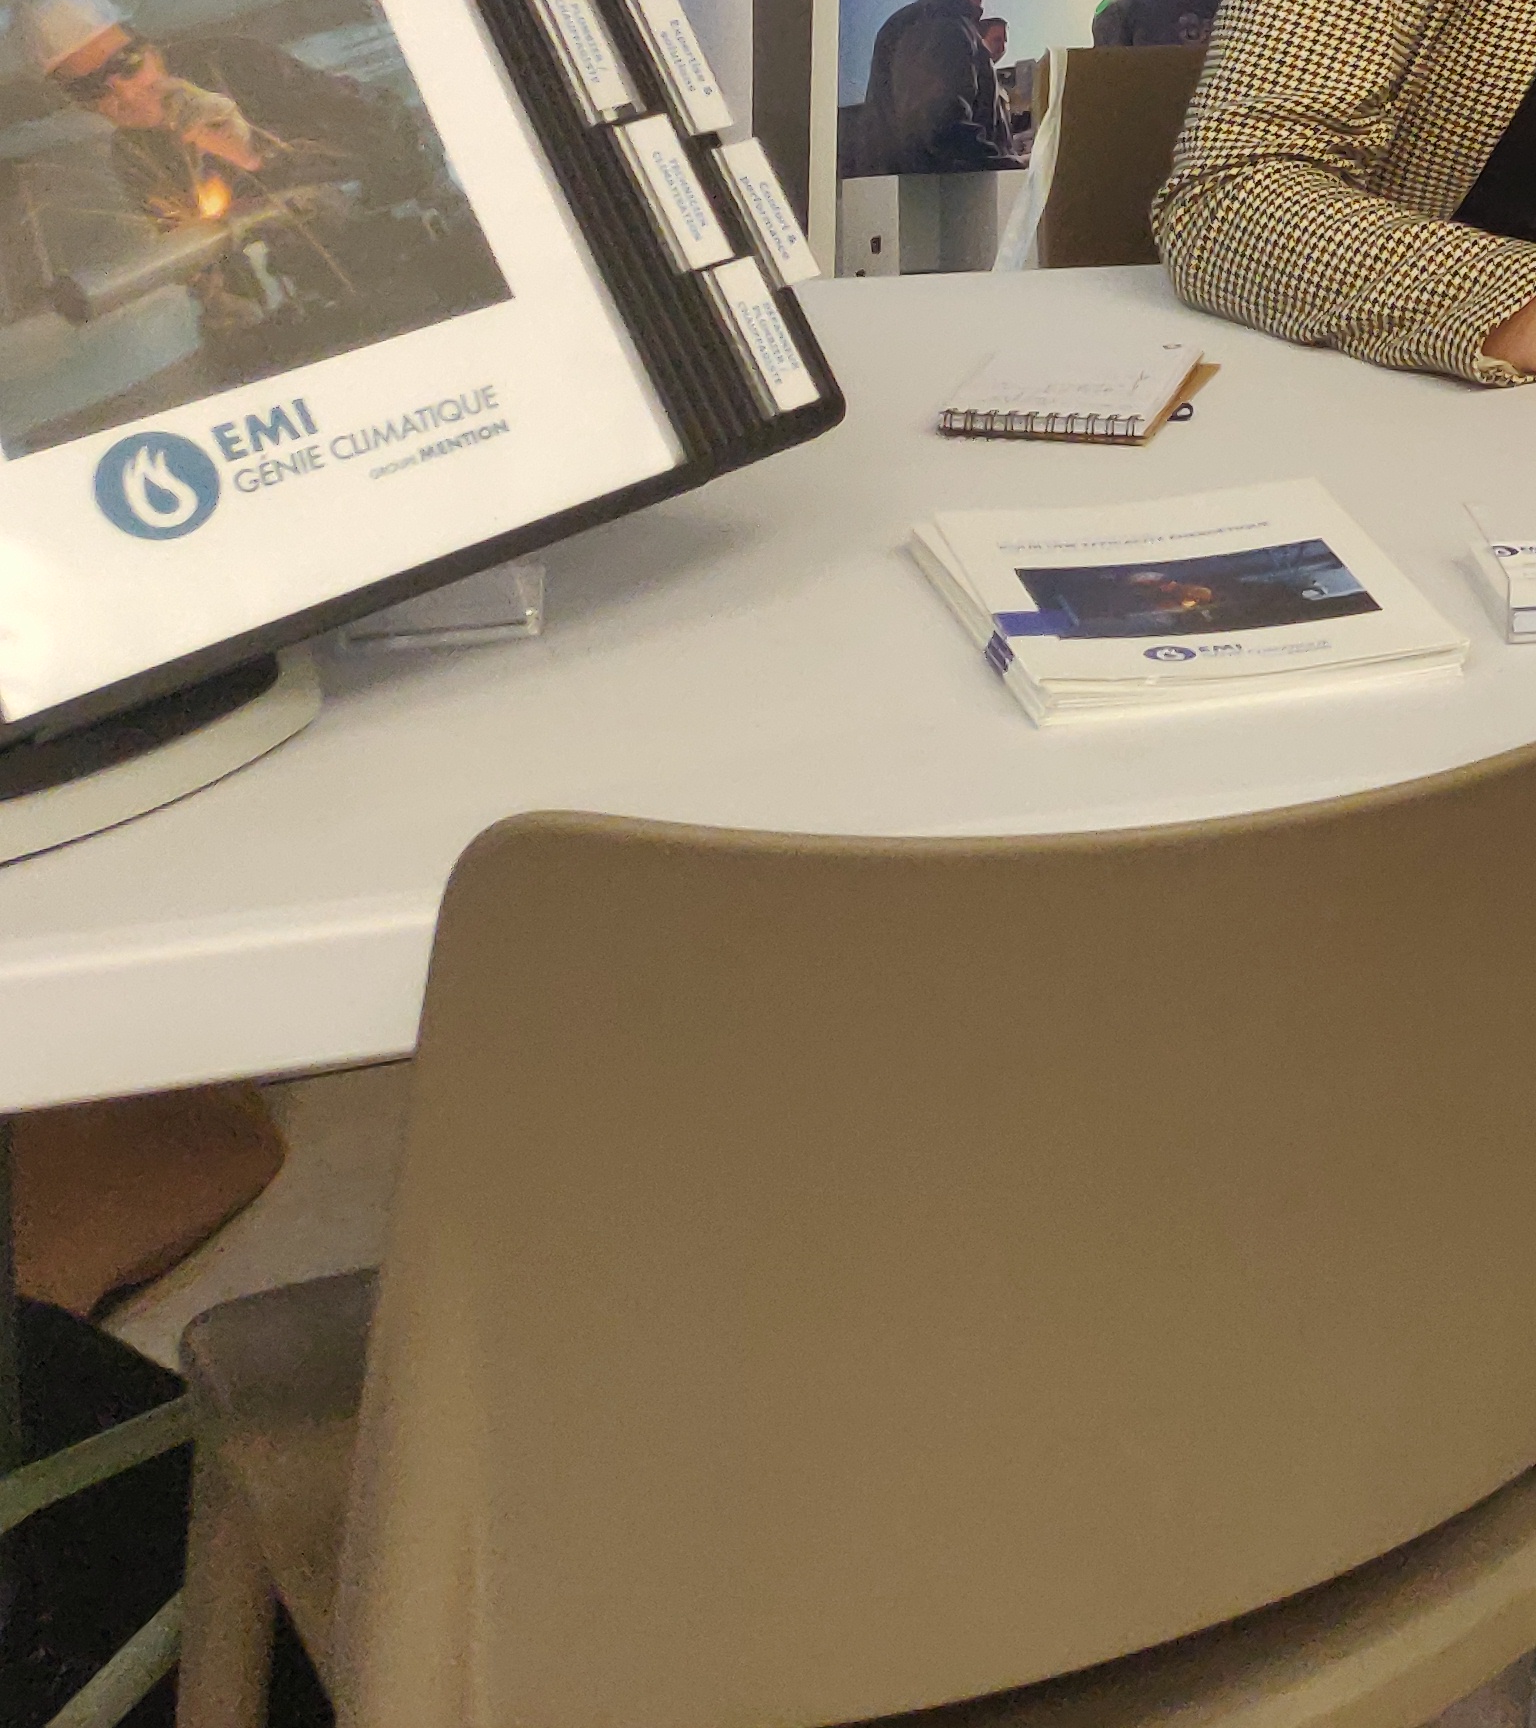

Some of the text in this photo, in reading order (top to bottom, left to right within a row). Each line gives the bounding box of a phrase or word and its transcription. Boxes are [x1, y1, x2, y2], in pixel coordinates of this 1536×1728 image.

[211, 397, 319, 463] EMI
[329, 384, 500, 461] CLIMATIQUE
[418, 418, 511, 463] MENTION
